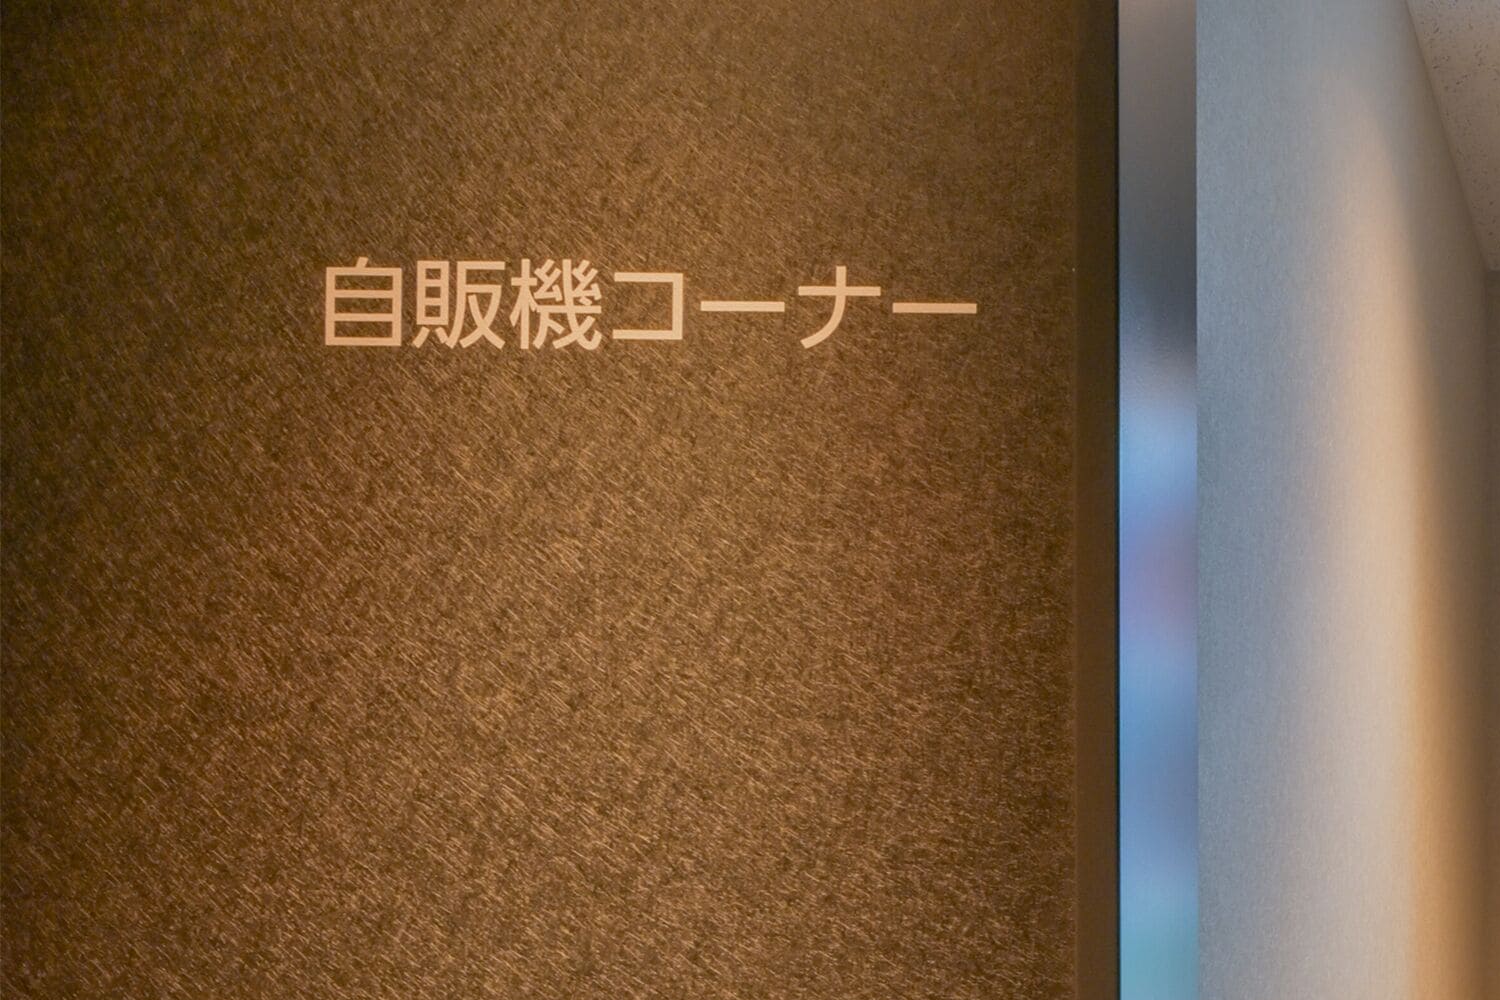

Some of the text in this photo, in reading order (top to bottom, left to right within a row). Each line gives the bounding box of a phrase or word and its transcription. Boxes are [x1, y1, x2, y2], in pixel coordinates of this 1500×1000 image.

[325, 257, 977, 349] 自販機コーナー
